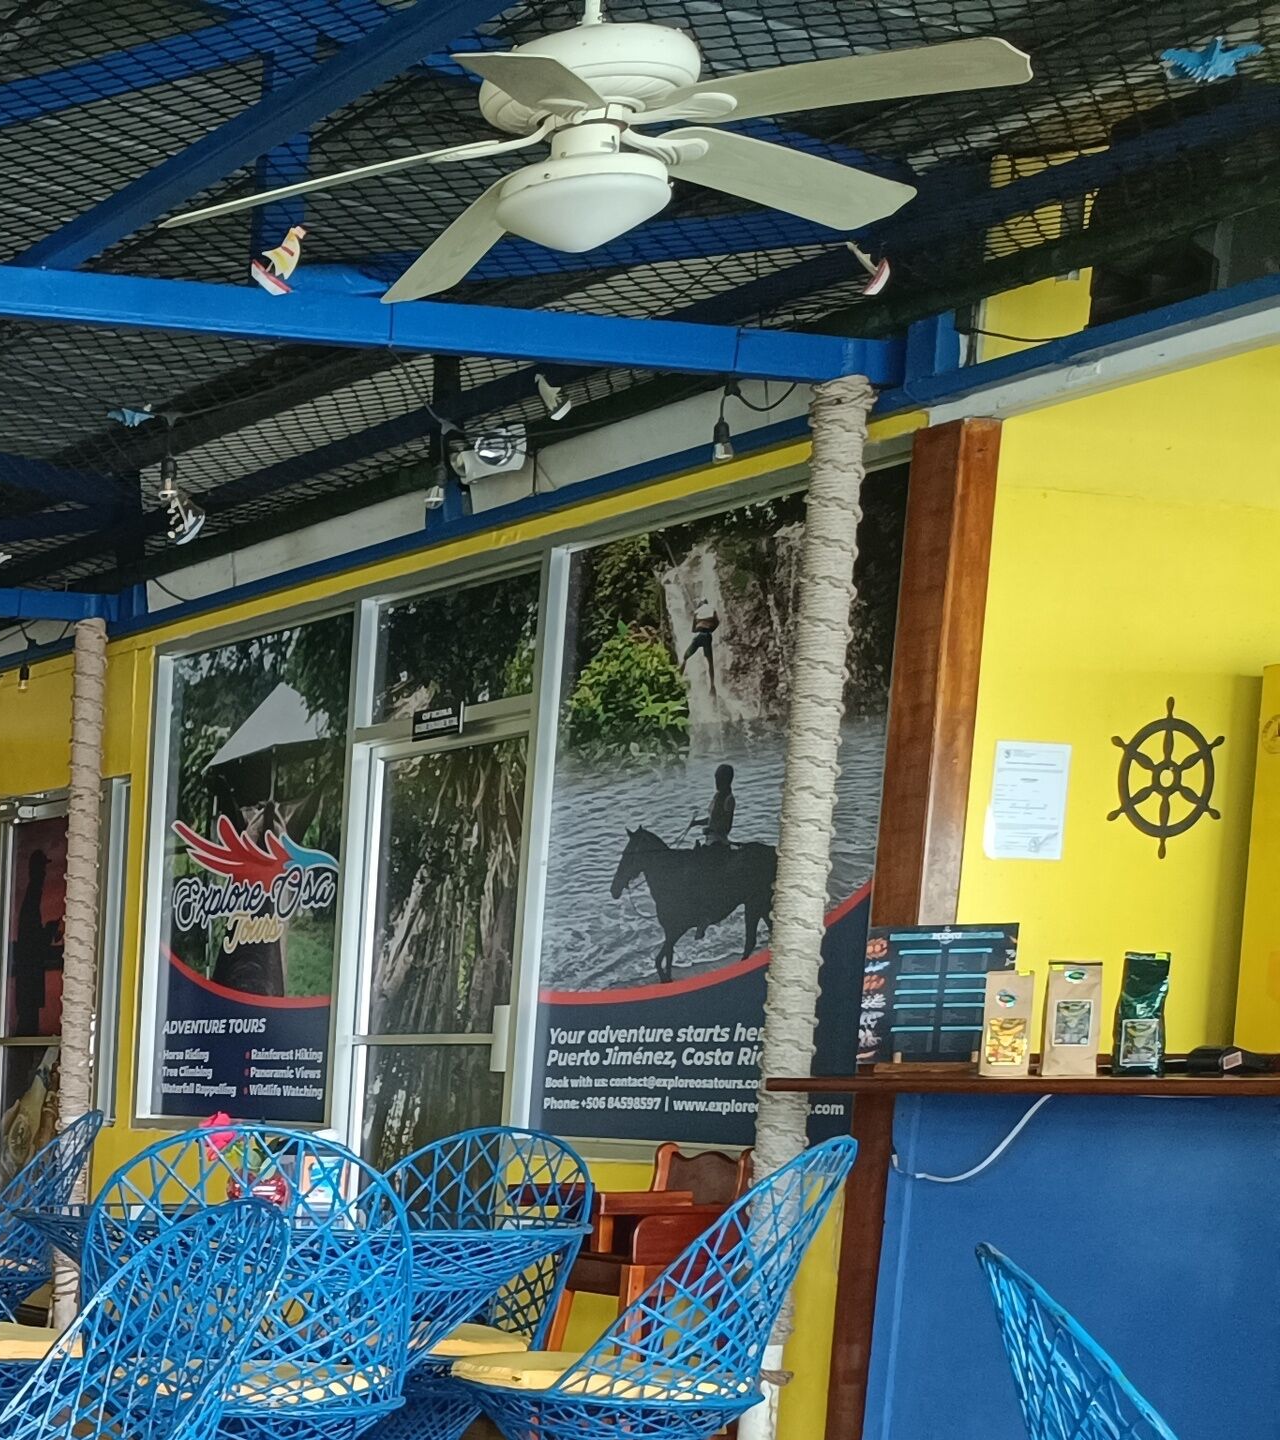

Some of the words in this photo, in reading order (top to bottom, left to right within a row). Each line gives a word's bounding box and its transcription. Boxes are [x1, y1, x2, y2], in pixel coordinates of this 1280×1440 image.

[172, 875, 270, 931] Explore
[272, 865, 336, 921] Osa
[224, 912, 284, 954] Tours
[162, 1019, 227, 1034] ADVENTURE
[228, 1018, 267, 1033] TOURS
[550, 1027, 586, 1045] Your
[587, 1025, 674, 1043] adventure
[676, 1025, 731, 1042] starts
[733, 1022, 765, 1042] her
[162, 1049, 184, 1060] Horse
[185, 1048, 210, 1062] Riding
[251, 1048, 294, 1060] Rainforest
[294, 1048, 323, 1063] Hiking
[546, 1049, 600, 1066] Puerto
[602, 1045, 677, 1069] Jiménez,
[682, 1047, 734, 1066] Costa
[161, 1066, 178, 1077] Tree
[179, 1065, 212, 1079] Climbing
[250, 1066, 294, 1078] Panoramic
[295, 1066, 321, 1078] Views
[545, 1077, 569, 1088] Book
[570, 1075, 593, 1088] with
[594, 1078, 608, 1088] us:
[609, 1075, 759, 1091] contact@exploreosatours.co
[249, 1084, 281, 1096] Wildlife
[282, 1085, 323, 1100] Watching
[607, 1096, 662, 1110] 84598597
